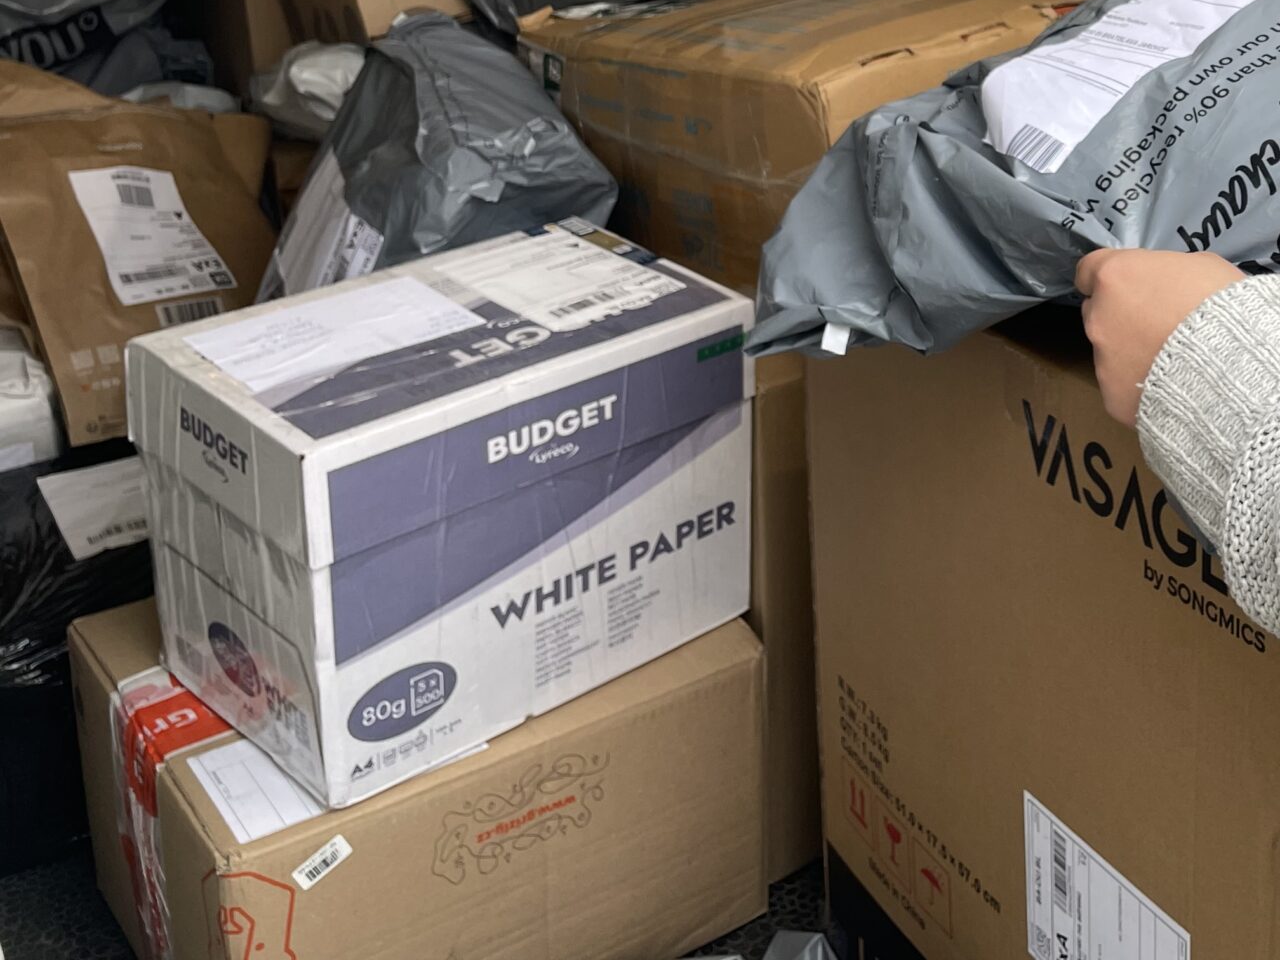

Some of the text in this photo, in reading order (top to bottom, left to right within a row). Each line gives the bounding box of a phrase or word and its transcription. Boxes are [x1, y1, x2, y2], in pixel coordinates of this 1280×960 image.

[1237, 31, 1271, 55] our
[1189, 55, 1236, 87] own
[1227, 53, 1277, 85] than
[1184, 83, 1231, 124] 90%
[1094, 86, 1190, 193] packaging
[1110, 123, 1185, 217] recycled
[180, 406, 249, 475] BUDGET
[486, 394, 618, 464] BUDGET
[490, 553, 617, 630] WHITE
[628, 500, 736, 573] PAPER
[1144, 559, 1267, 654] by SONGMICS
[361, 698, 407, 727] 80g
[416, 688, 441, 709] 500
[350, 757, 375, 778] A4
